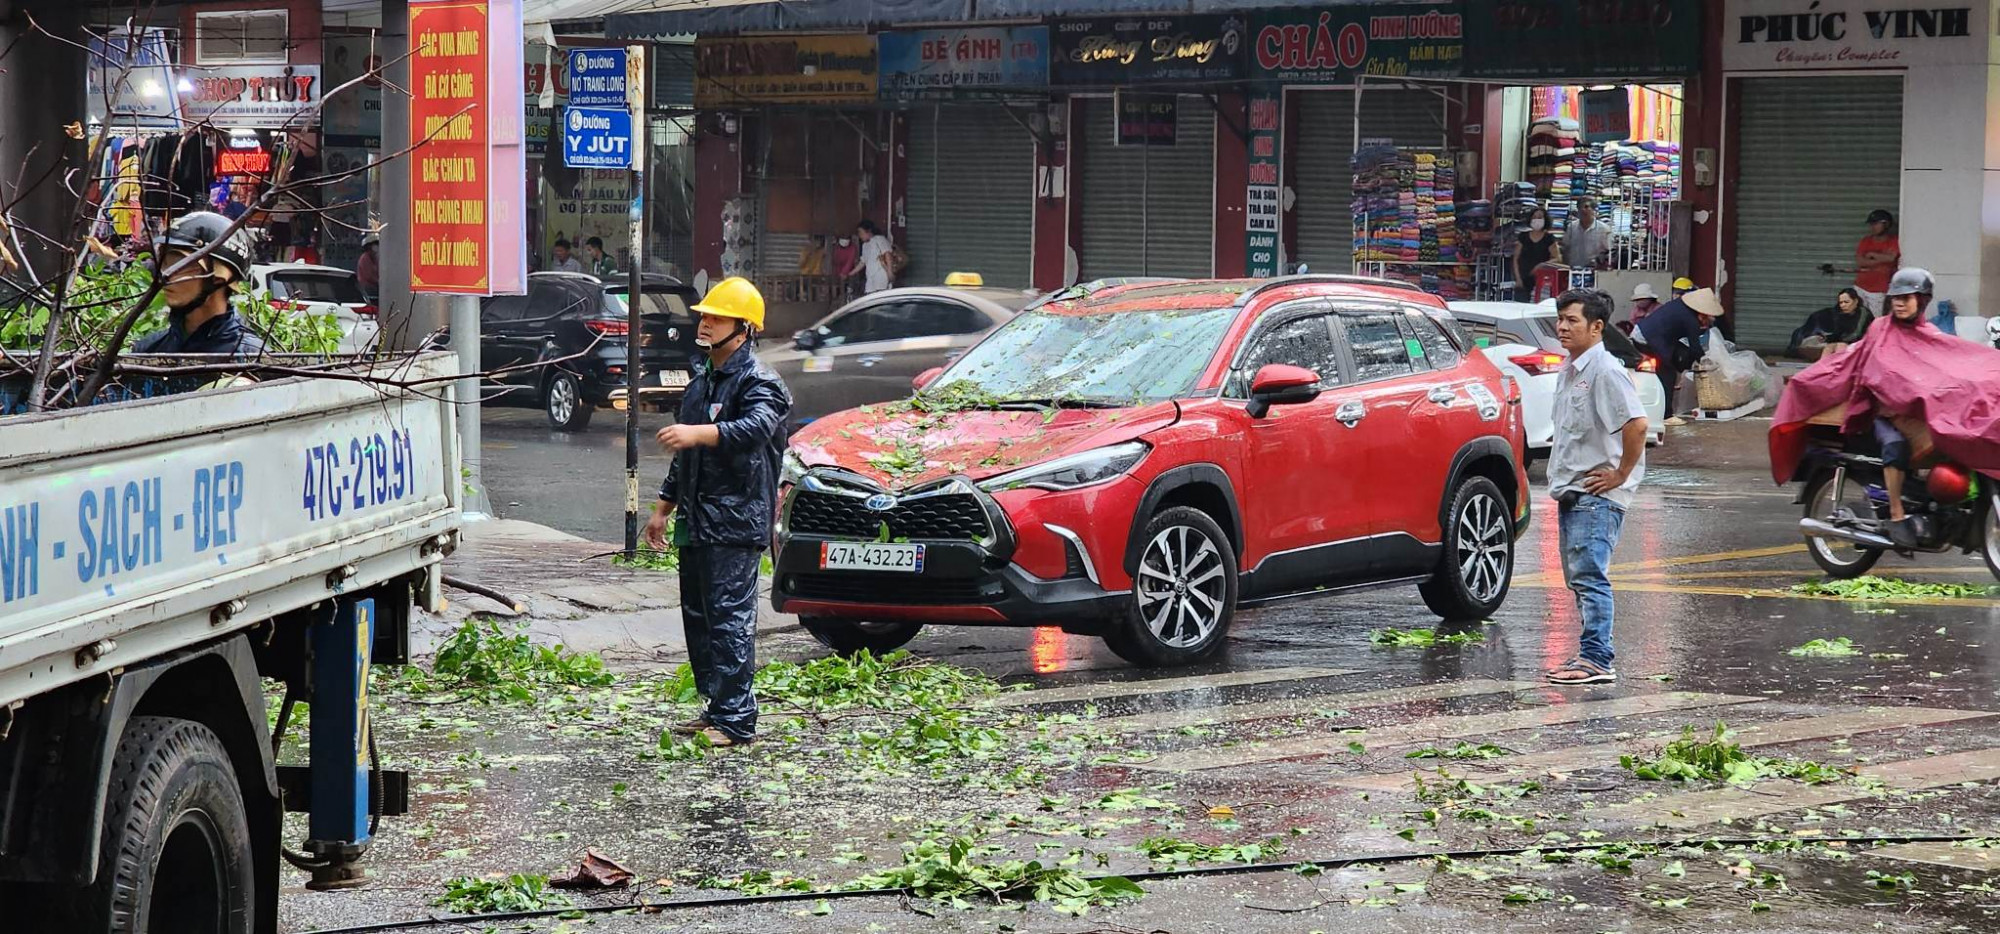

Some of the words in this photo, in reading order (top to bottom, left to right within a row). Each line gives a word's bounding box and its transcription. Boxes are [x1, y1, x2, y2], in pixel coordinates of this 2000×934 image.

[1059, 23, 1092, 32] SHOP
[1370, 16, 1407, 40] DINH
[1738, 1, 1846, 43] PHÚC
[1863, 8, 1971, 39] VINH
[420, 27, 438, 58] CÁC
[439, 31, 456, 57] VUA
[456, 26, 479, 57] HÙNG
[921, 35, 948, 60] BÉ
[956, 35, 1002, 61] ÁNH
[1256, 11, 1367, 69] CHÁO
[192, 77, 247, 102] SHOP
[249, 66, 315, 102] THỦY
[425, 70, 437, 99] ĐÃ
[439, 69, 449, 98] CÓ
[450, 68, 474, 98] CÔNG
[582, 76, 605, 92] TRANG
[606, 76, 625, 92] LONG
[567, 135, 582, 152] Y
[587, 131, 629, 153] JÚT
[422, 152, 440, 182] BÁC
[441, 152, 463, 182] CHÁU
[465, 157, 476, 182] TA
[461, 199, 484, 224] NHAU
[1250, 218, 1264, 229] CAM
[1249, 234, 1274, 247] DÀNH
[1252, 252, 1271, 262] CHO
[303, 427, 414, 521] 47C-219.91
[77, 476, 162, 597] SẠCH
[192, 460, 244, 565] ĐẸP
[829, 547, 914, 567] 47A-432.23
